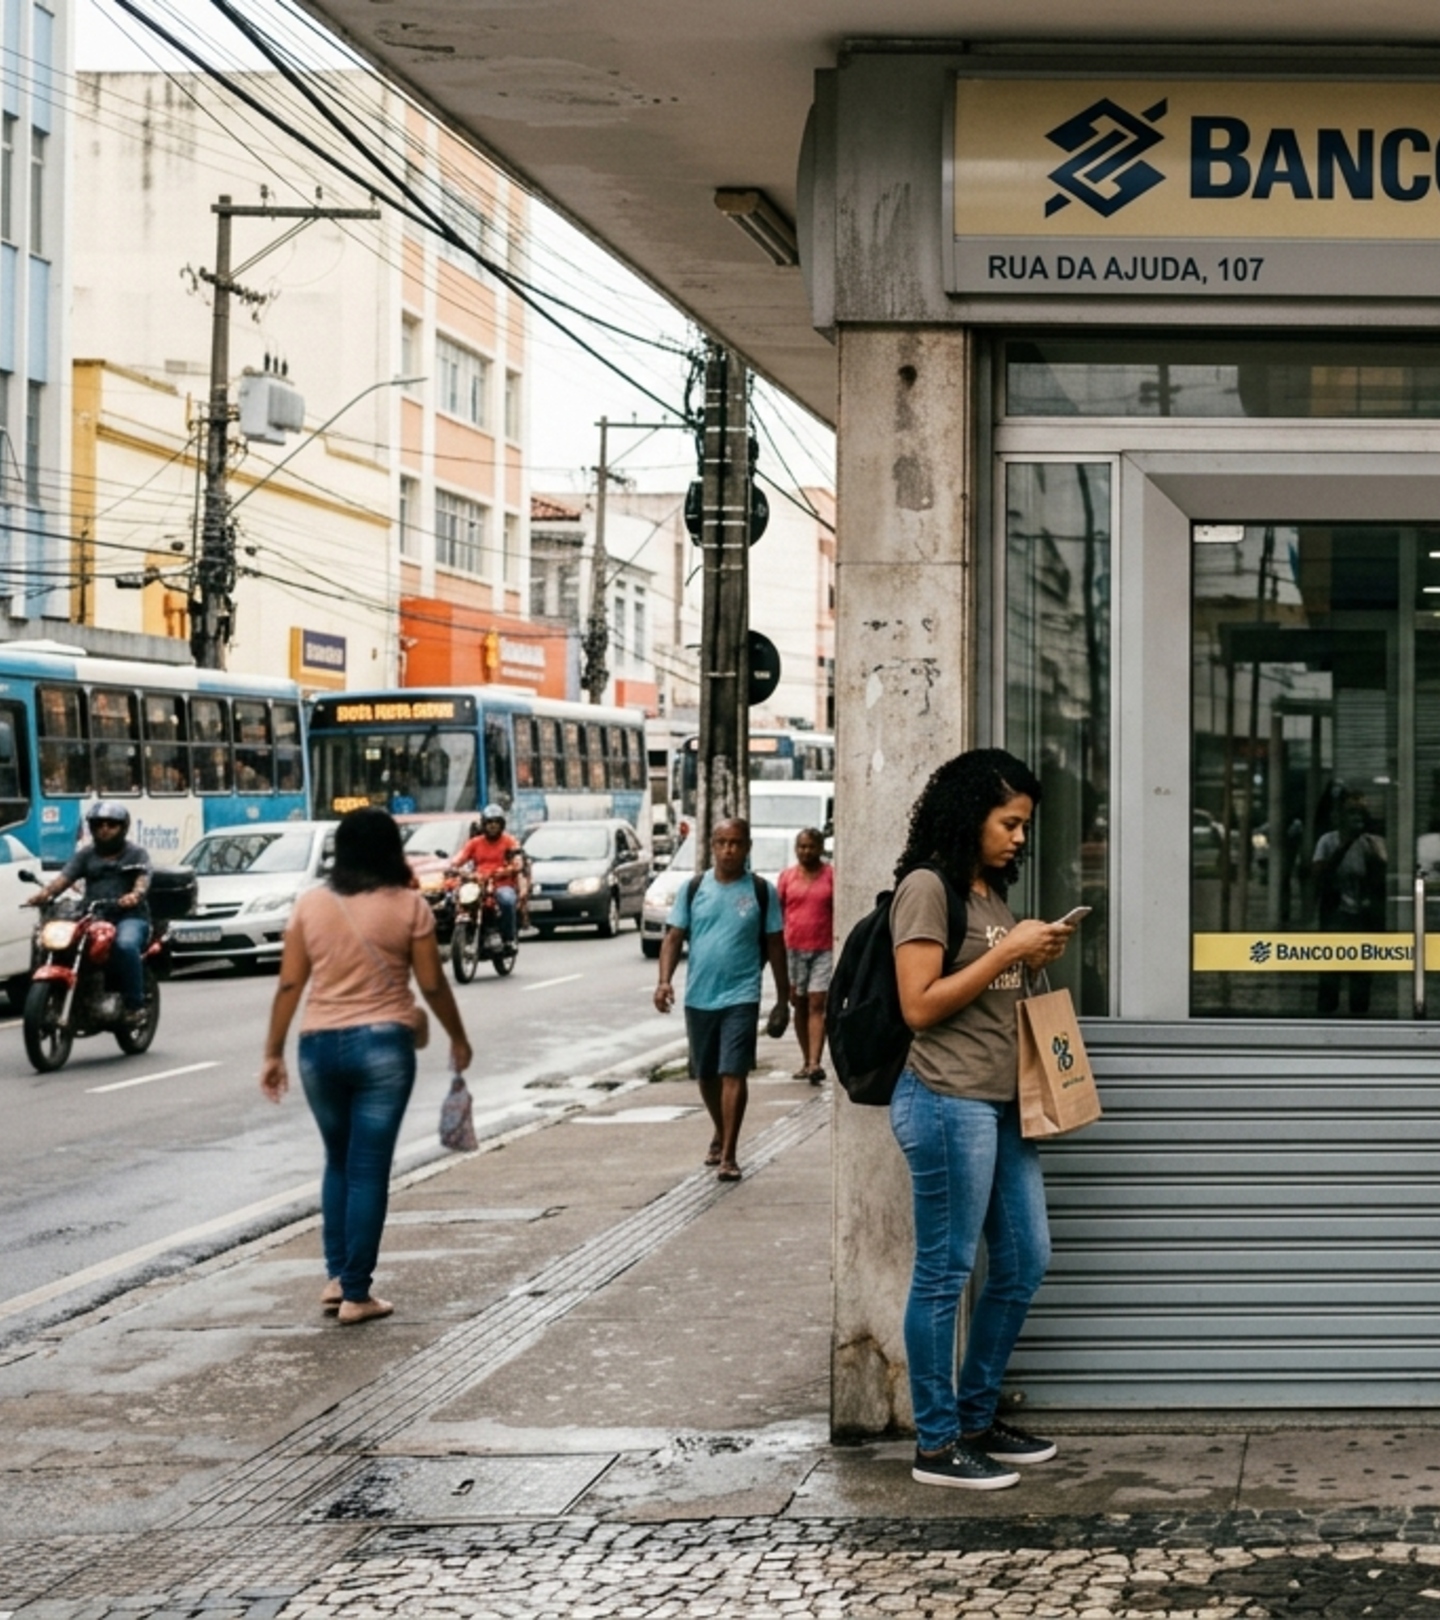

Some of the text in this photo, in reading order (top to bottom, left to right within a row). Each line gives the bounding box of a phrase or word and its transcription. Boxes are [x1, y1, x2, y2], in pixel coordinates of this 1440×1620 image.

[988, 255, 1264, 284] RUA DA AJUDA, 107
